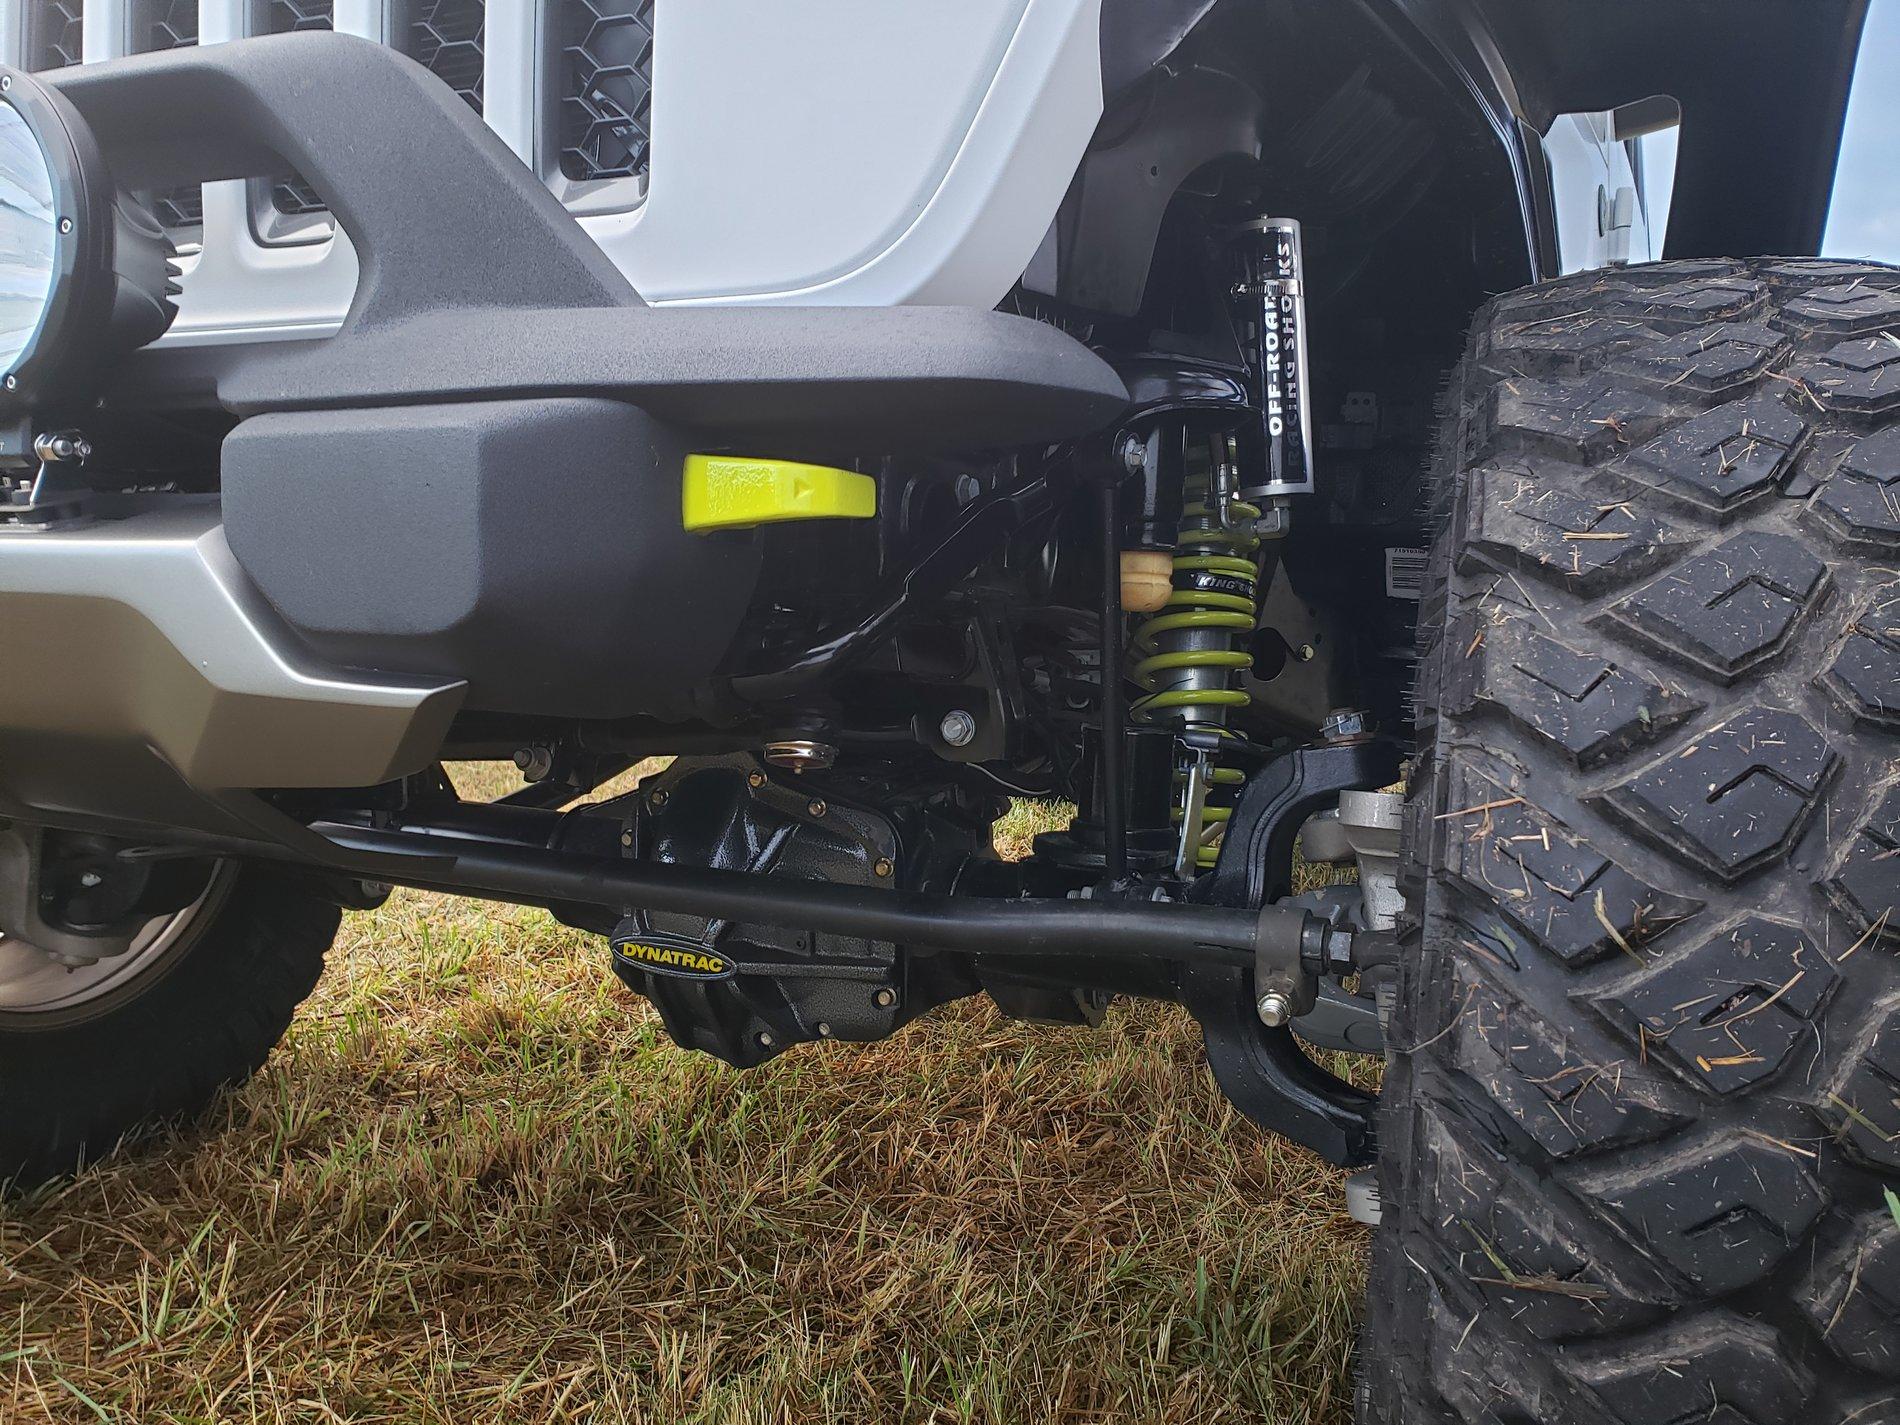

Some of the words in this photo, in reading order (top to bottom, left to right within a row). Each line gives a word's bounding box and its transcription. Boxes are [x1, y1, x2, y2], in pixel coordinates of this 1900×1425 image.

[1278, 242, 1295, 350] SHOKS
[1263, 296, 1283, 436] OFF-ROAD
[1198, 575, 1236, 590] KING
[623, 942, 723, 973] DYNATRAC
